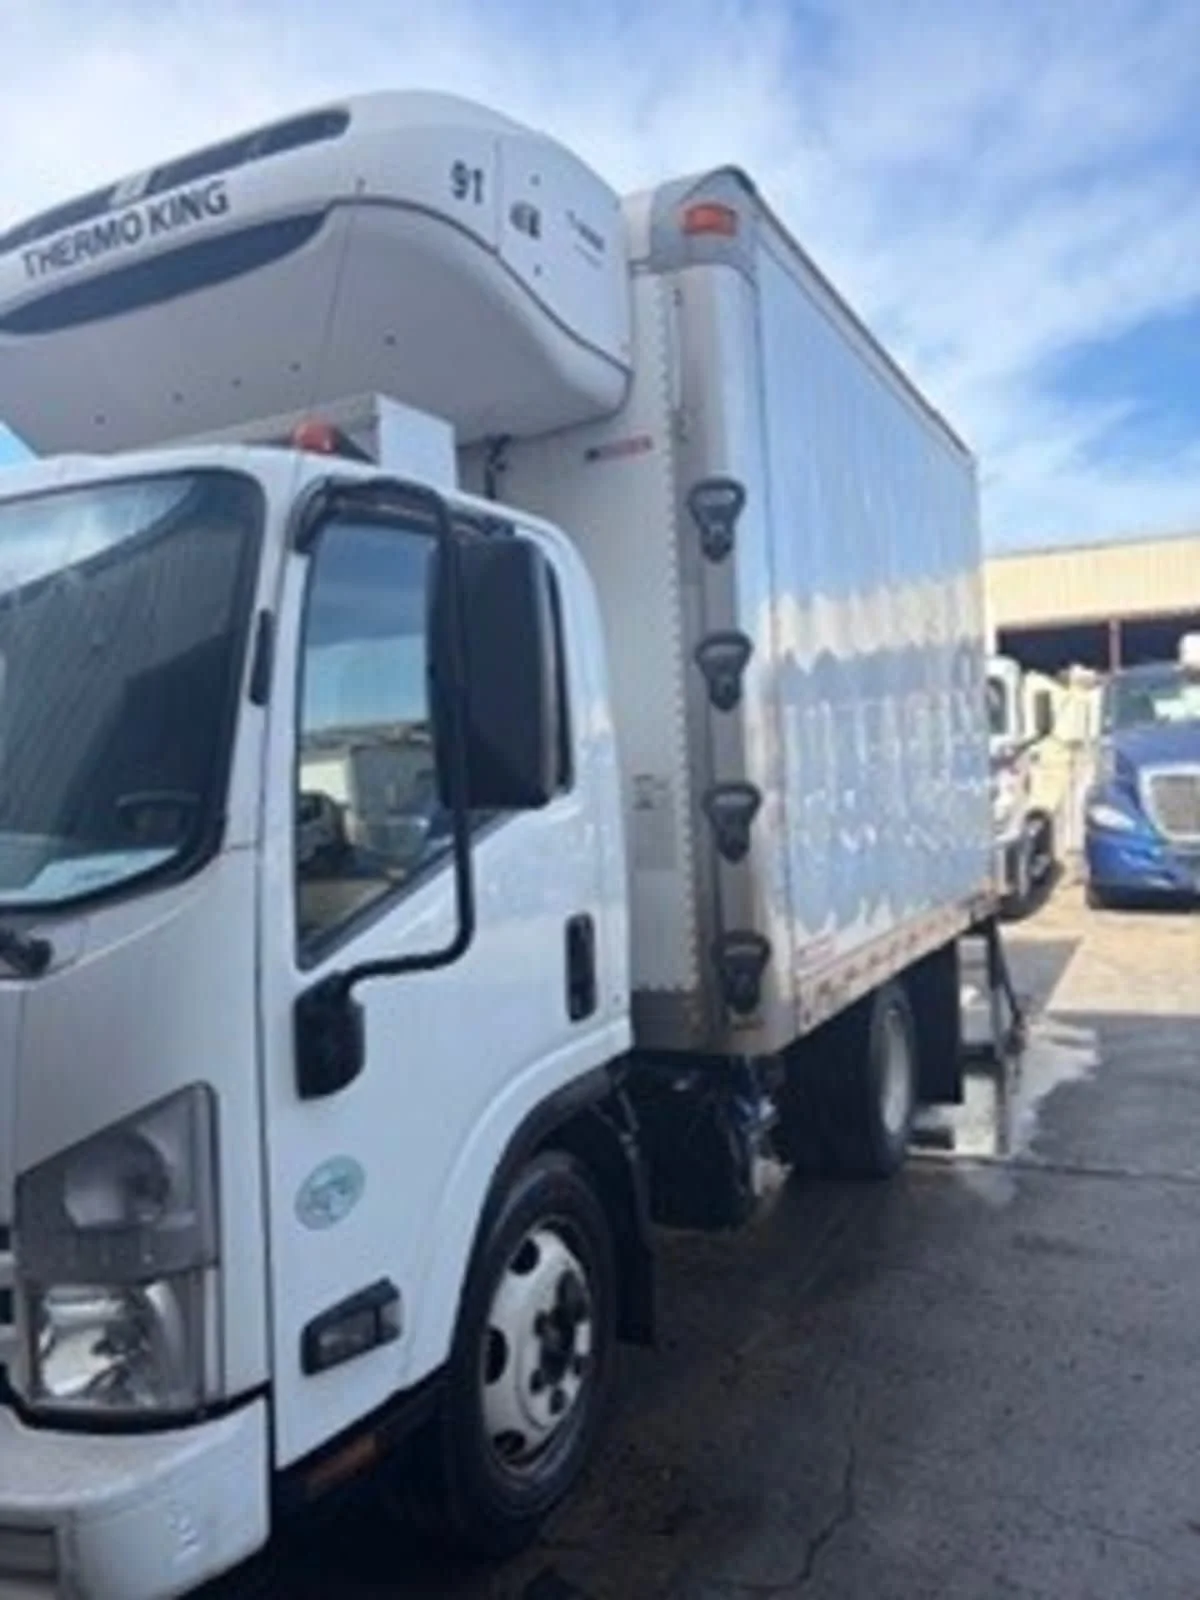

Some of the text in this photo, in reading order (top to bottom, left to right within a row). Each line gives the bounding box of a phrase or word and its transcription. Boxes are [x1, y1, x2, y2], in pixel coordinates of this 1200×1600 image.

[451, 159, 484, 205] 91
[21, 179, 230, 278] THERMO KING
